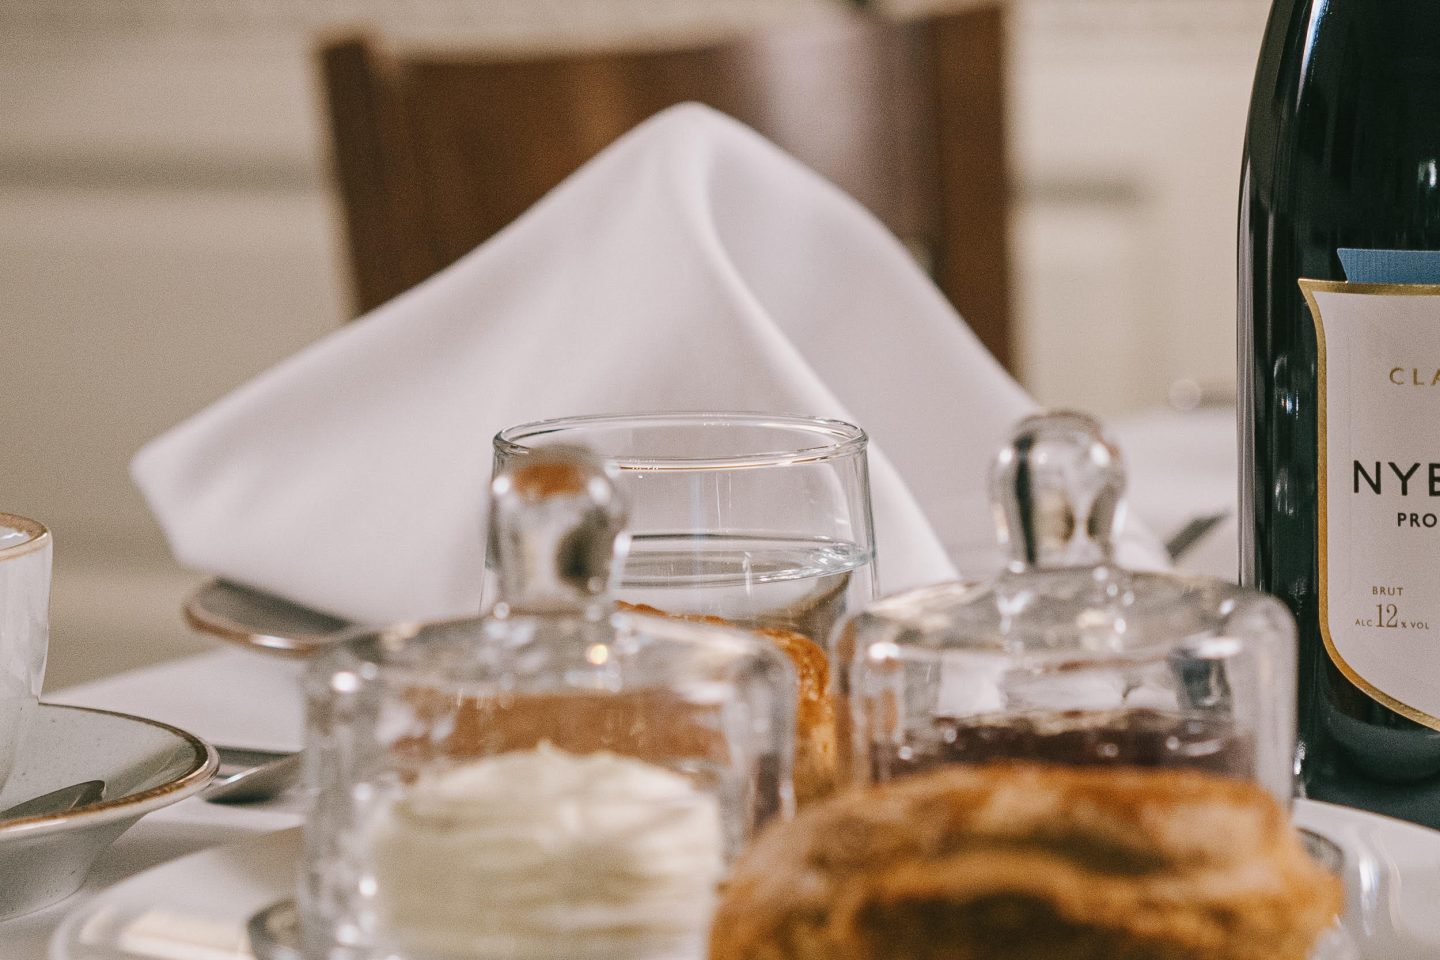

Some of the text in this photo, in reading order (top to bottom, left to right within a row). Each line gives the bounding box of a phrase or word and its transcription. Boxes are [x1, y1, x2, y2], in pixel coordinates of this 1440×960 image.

[1372, 586, 1403, 596] BRUT
[1355, 619, 1373, 627] ALC
[1410, 621, 1429, 630] VOL
